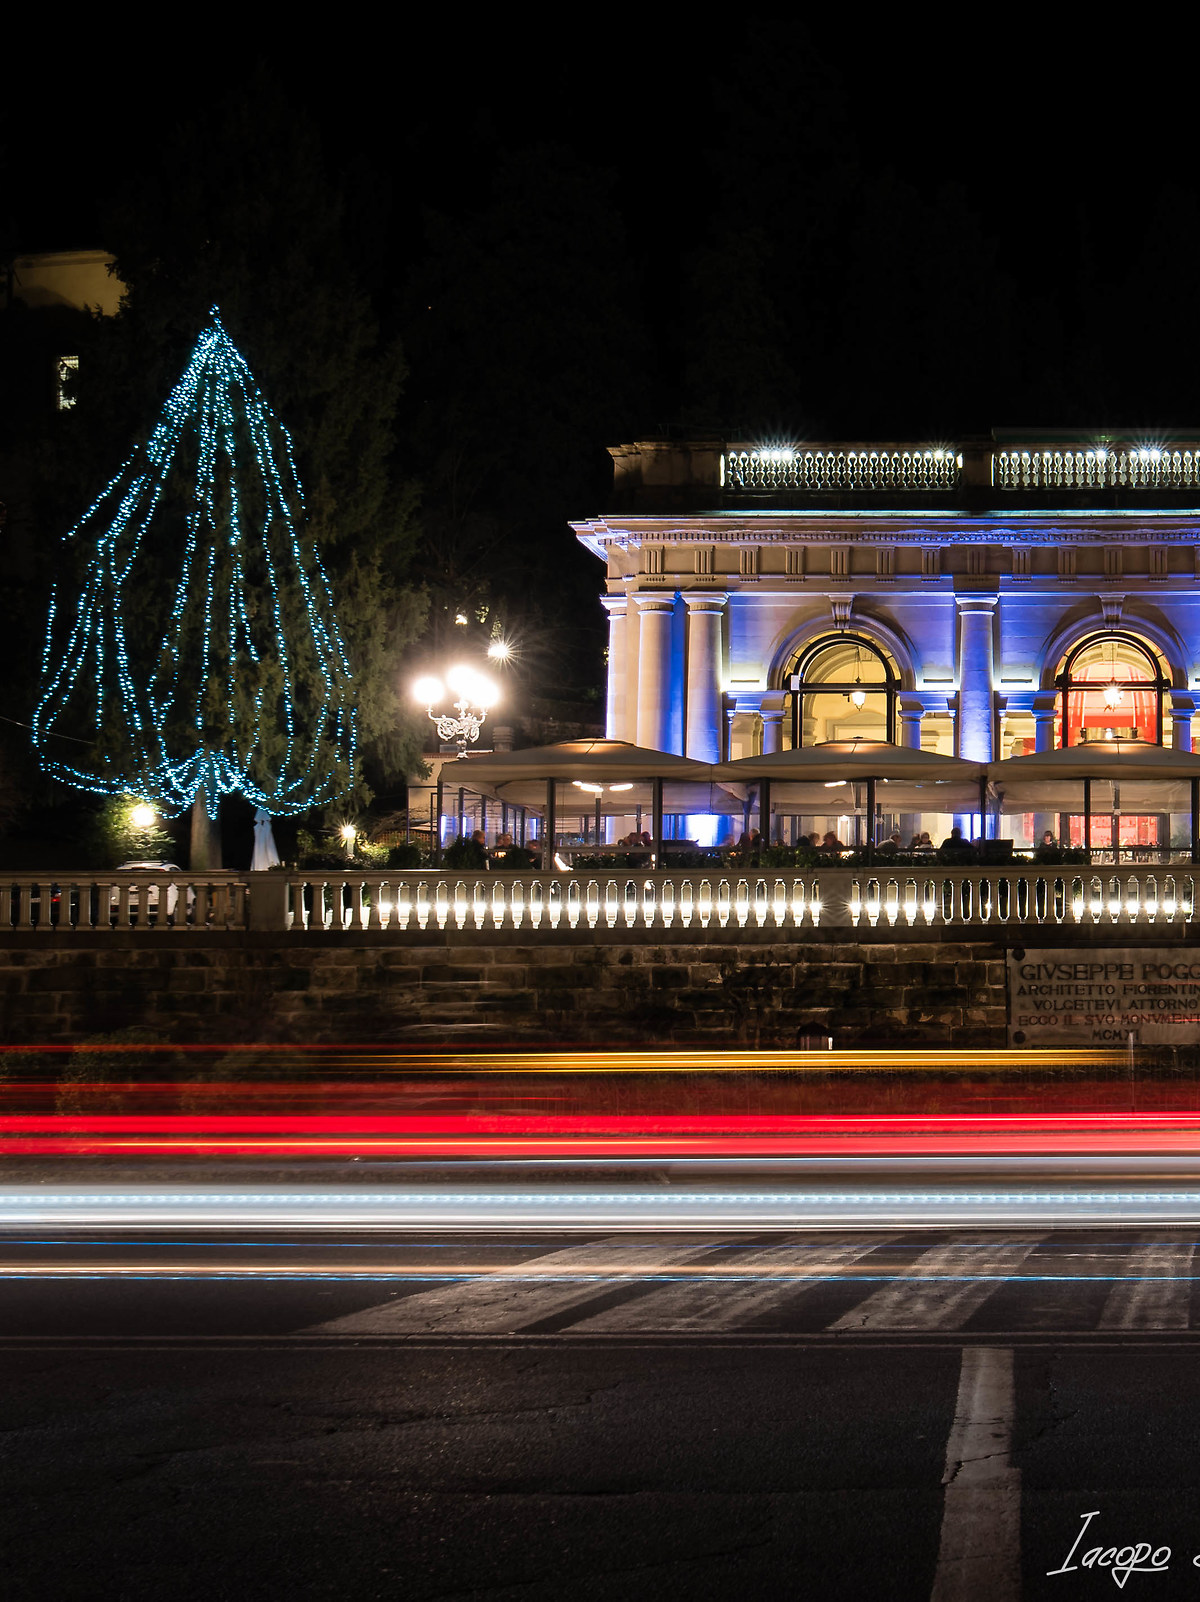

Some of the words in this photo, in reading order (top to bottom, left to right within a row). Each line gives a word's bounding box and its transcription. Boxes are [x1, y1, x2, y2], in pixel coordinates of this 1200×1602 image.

[1020, 963, 1134, 980] GIVSEPPE
[1017, 984, 1116, 996] ARCHITETTO
[1033, 999, 1121, 1011] VOLGETEVI
[1128, 998, 1199, 1010] ATTORNO
[1018, 1015, 1059, 1026] ECCO
[1063, 1014, 1078, 1026] IL
[1084, 1014, 1115, 1026] SVO
